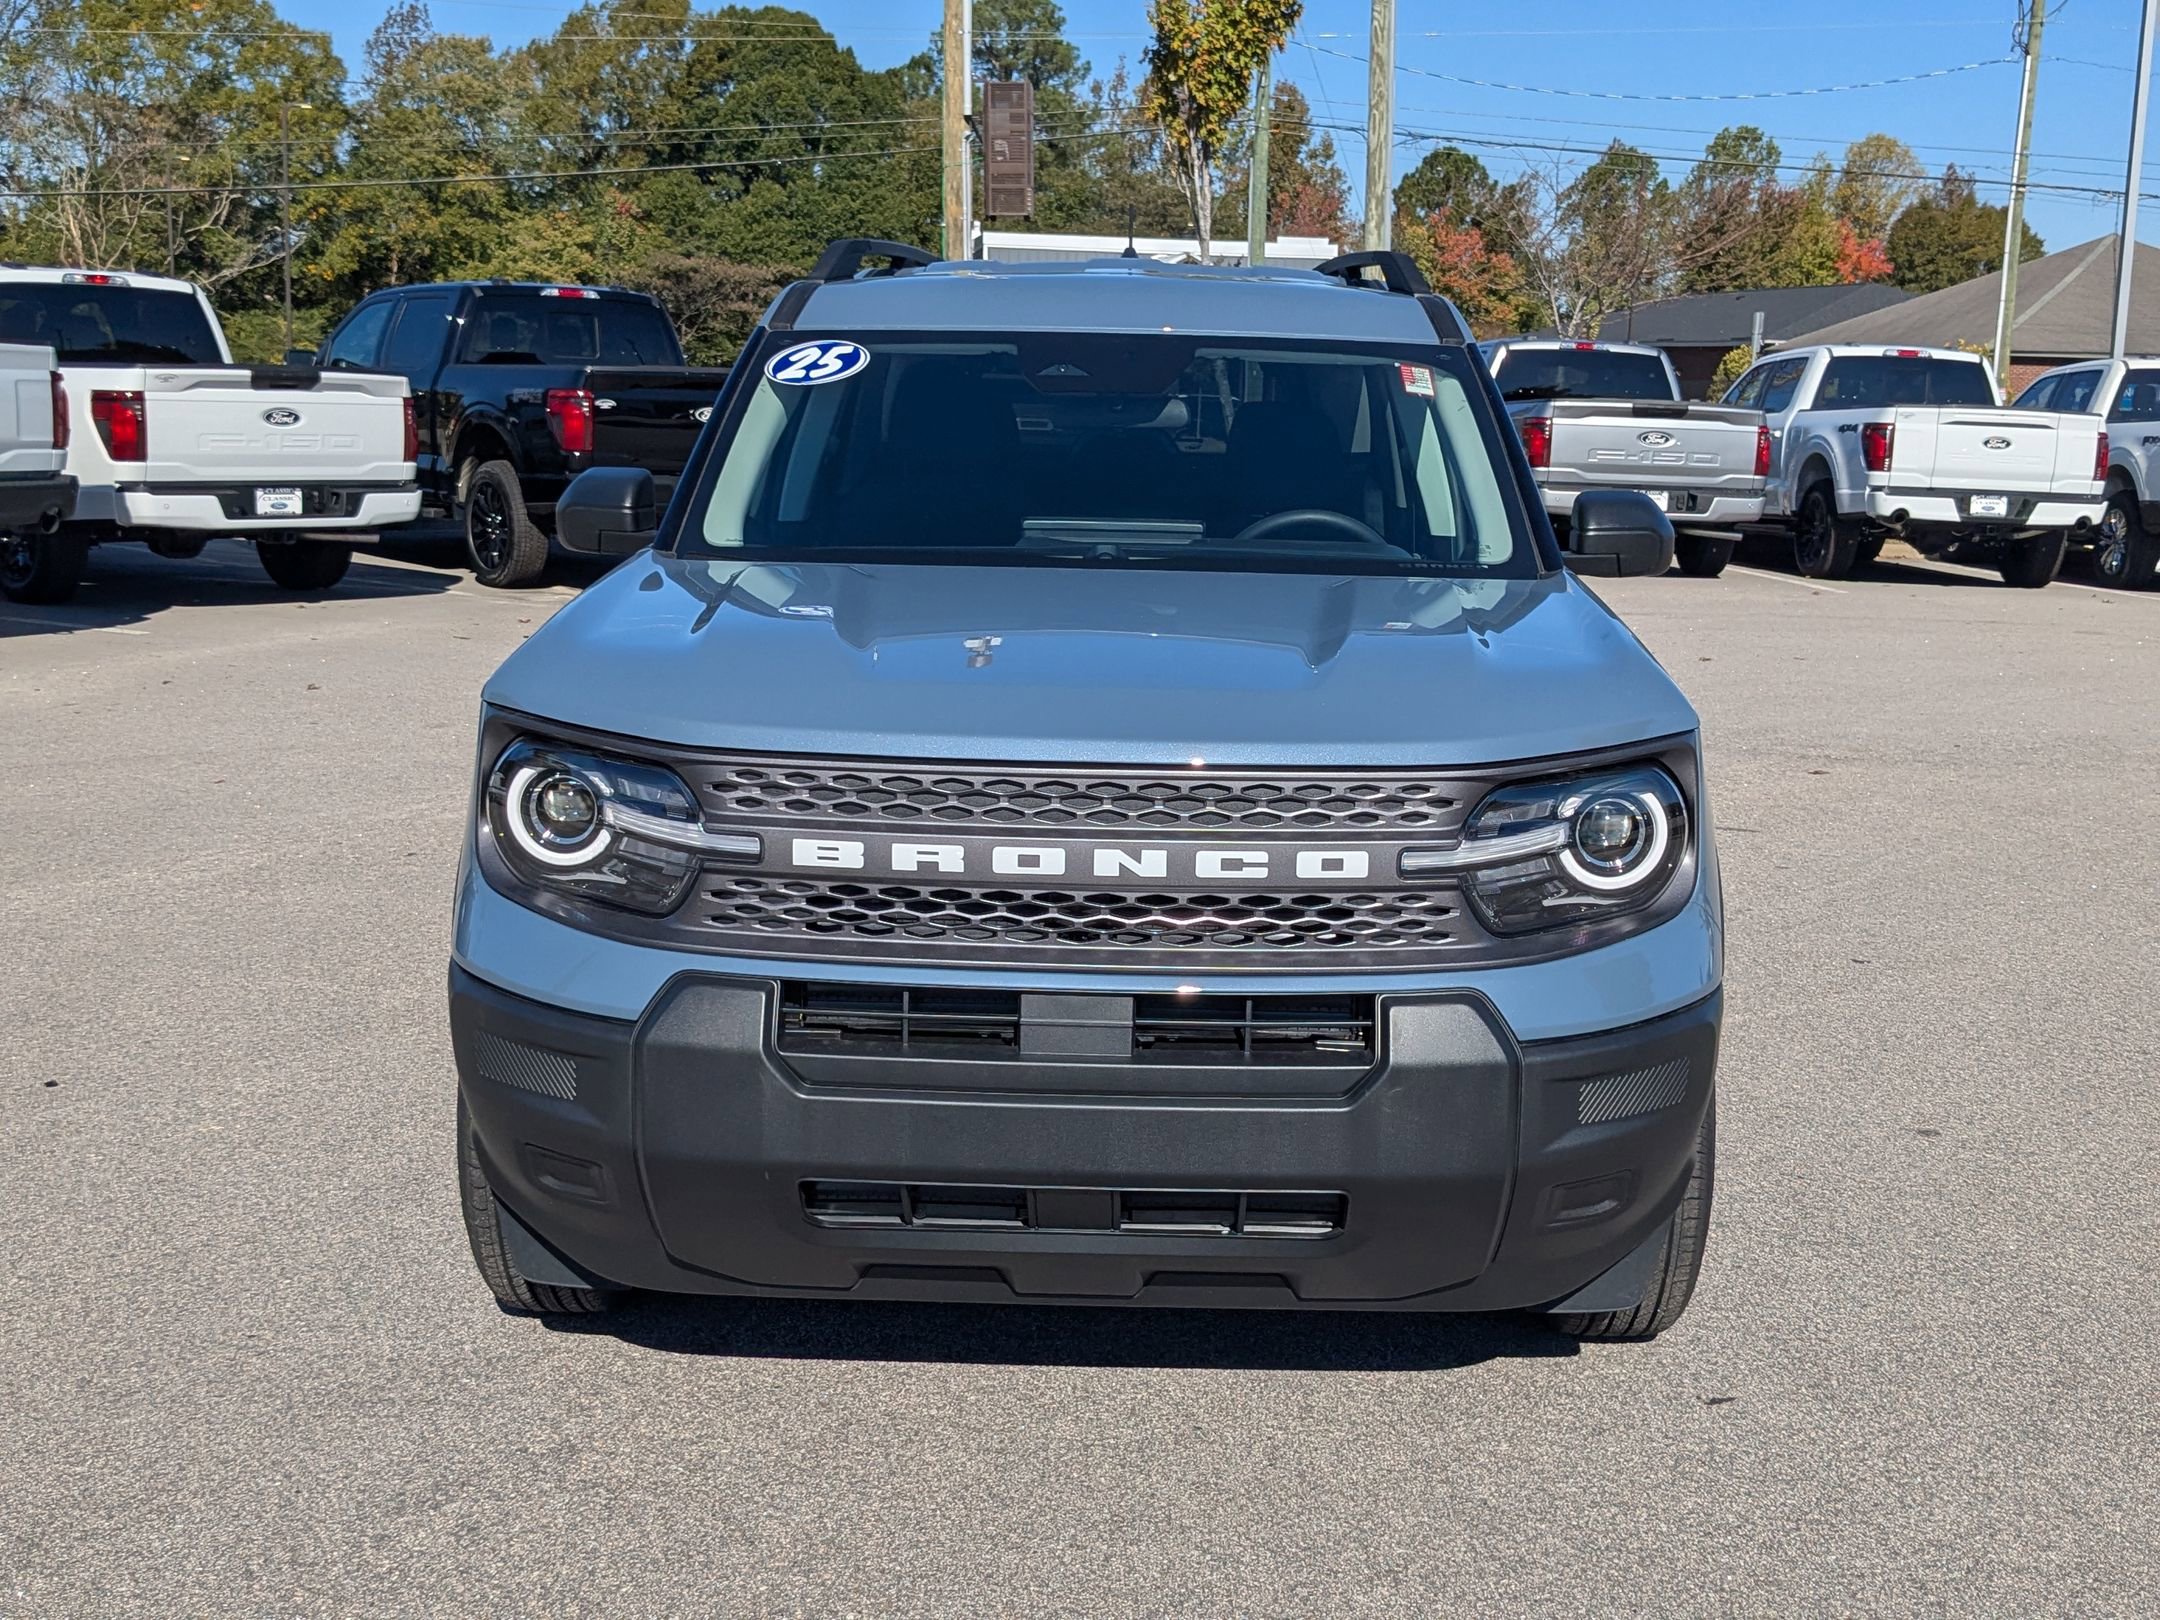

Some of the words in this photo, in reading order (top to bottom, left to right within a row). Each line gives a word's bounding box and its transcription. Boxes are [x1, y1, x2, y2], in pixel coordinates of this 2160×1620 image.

[775, 346, 855, 380] 25
[269, 410, 297, 424] Ford
[1587, 447, 1721, 467] F-150
[792, 838, 1370, 880] BRONCO
